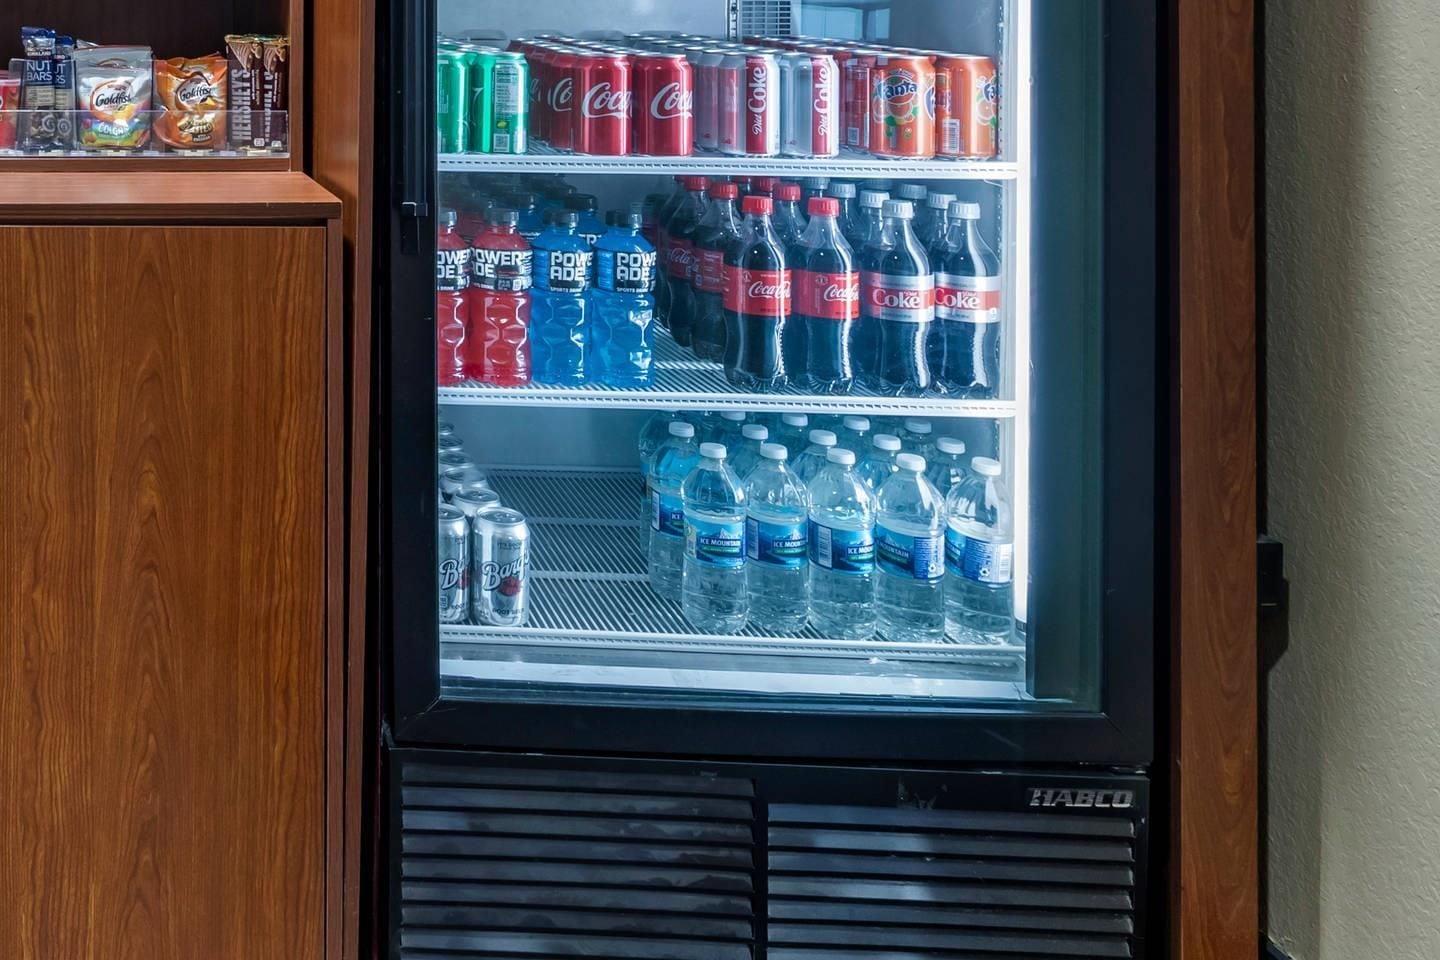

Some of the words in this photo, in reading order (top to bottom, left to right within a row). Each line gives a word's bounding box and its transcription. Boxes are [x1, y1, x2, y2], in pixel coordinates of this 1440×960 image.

[26, 60, 52, 72] NUT
[26, 71, 53, 81] BARS
[747, 66, 767, 113] Coke
[814, 65, 830, 113] Coke
[550, 266, 586, 281] ADE
[616, 265, 651, 281] ADE
[872, 288, 921, 309] Coke
[935, 287, 980, 310] Coke
[700, 537, 709, 545] ICE
[847, 547, 857, 555] ICE
[1029, 788, 1134, 808] HABCO
